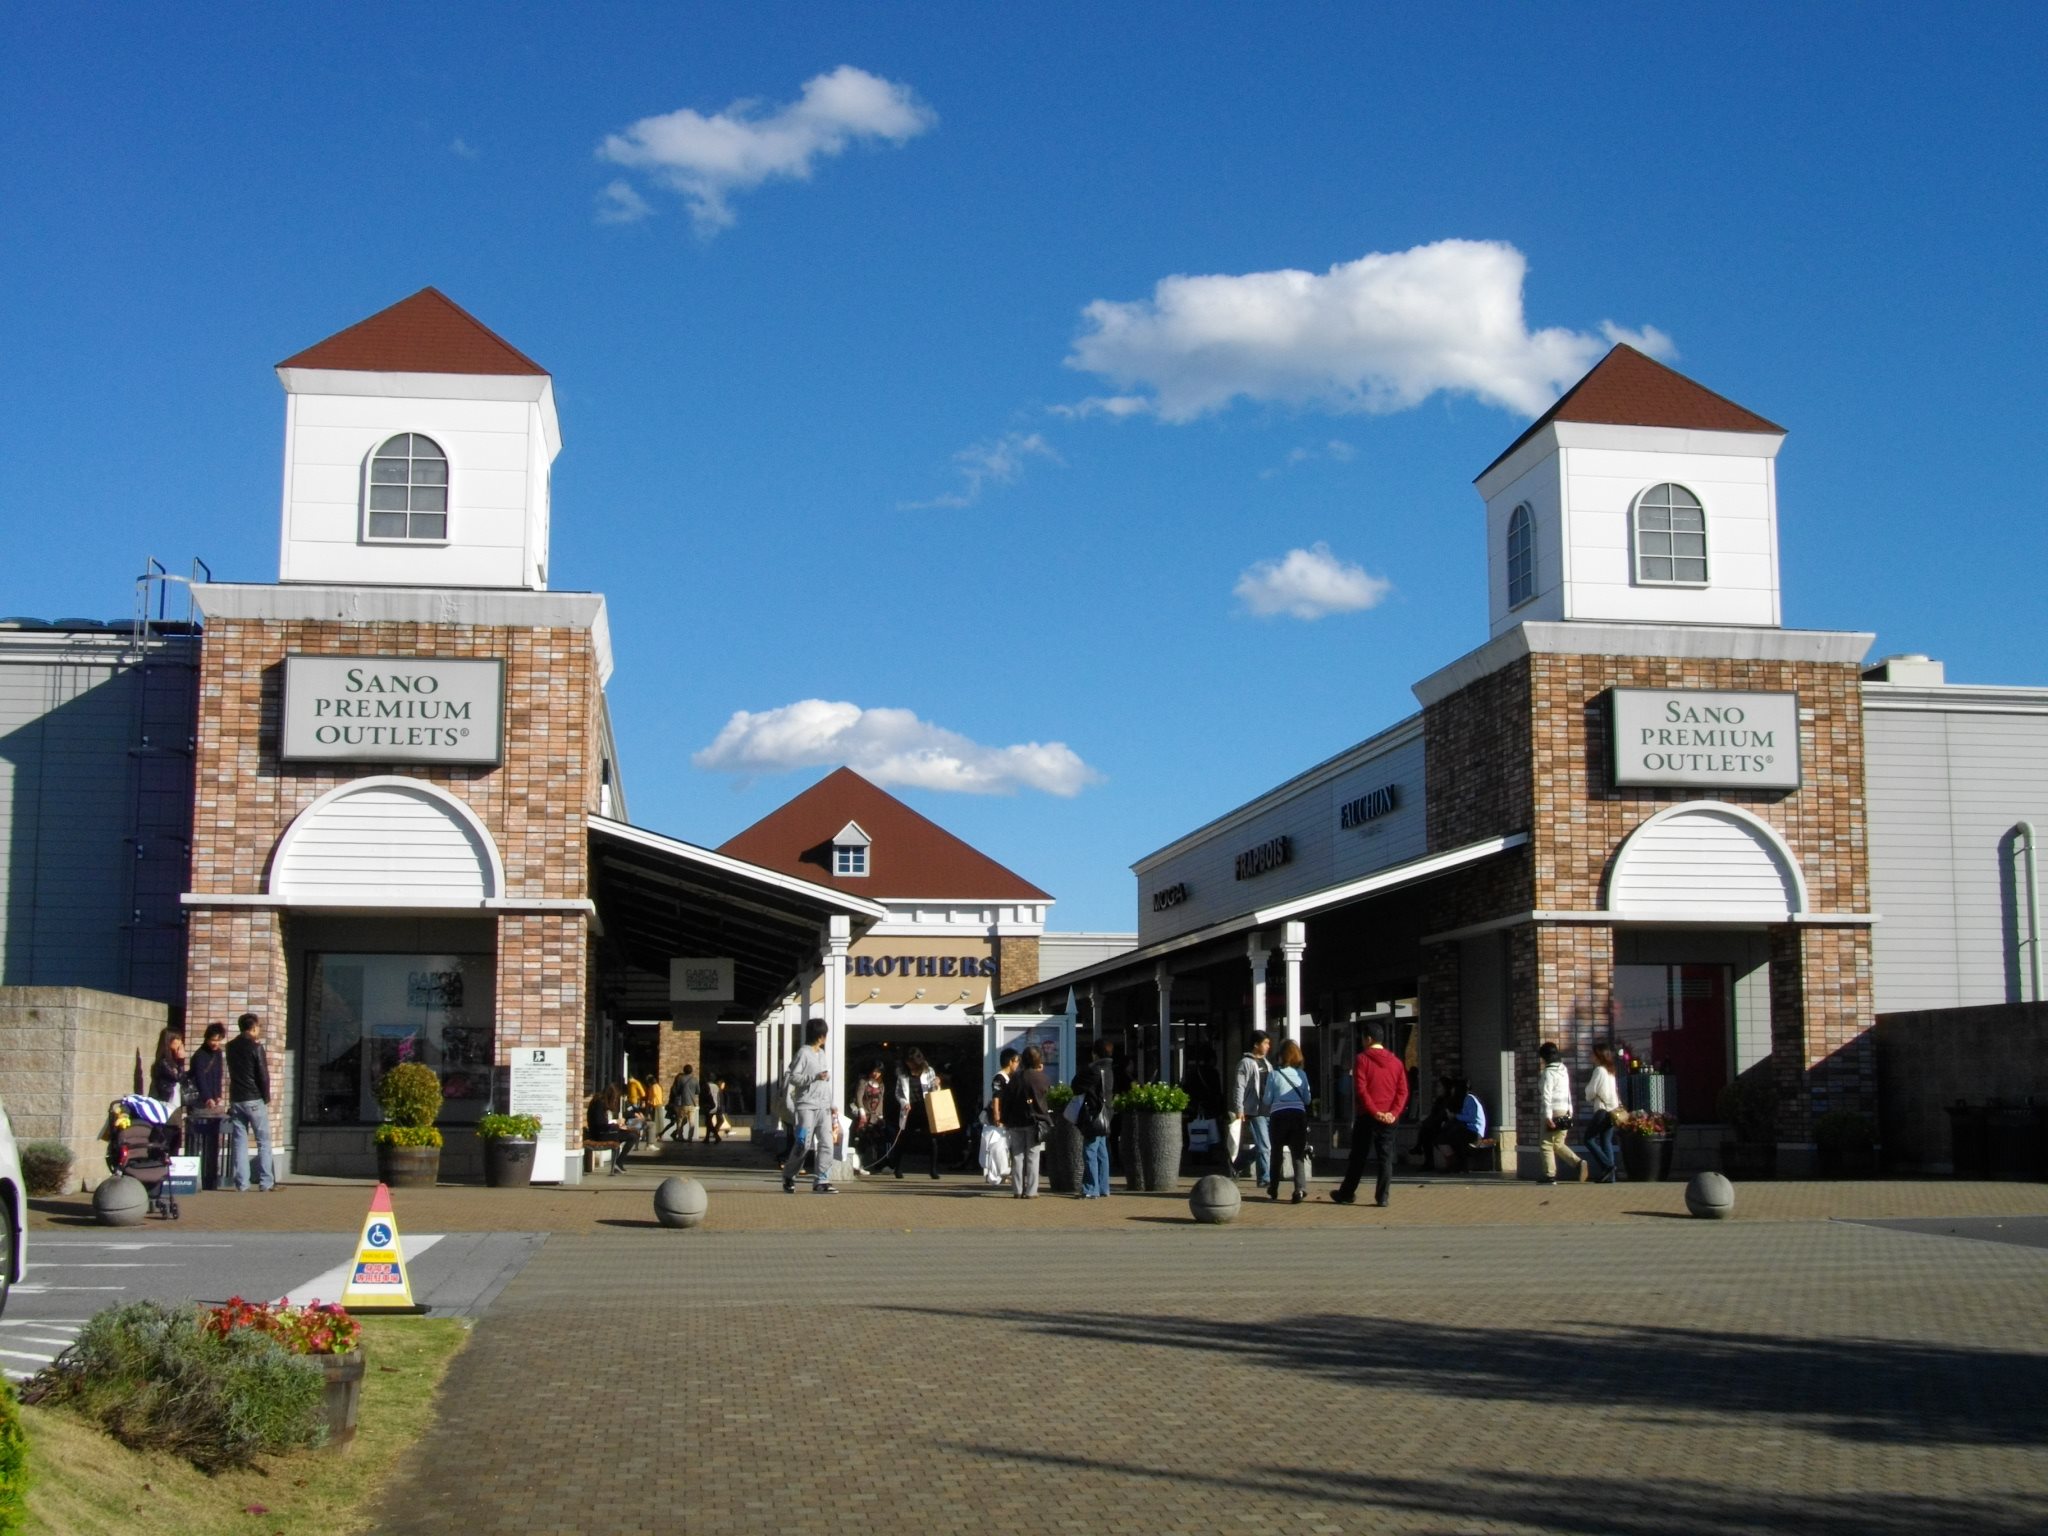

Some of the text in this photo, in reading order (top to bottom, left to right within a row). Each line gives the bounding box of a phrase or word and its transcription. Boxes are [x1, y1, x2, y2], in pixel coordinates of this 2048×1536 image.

[315, 699, 472, 720] PREMIUM
[1641, 728, 1774, 748] PREMIUM
[1341, 784, 1395, 829] FAUCHON
